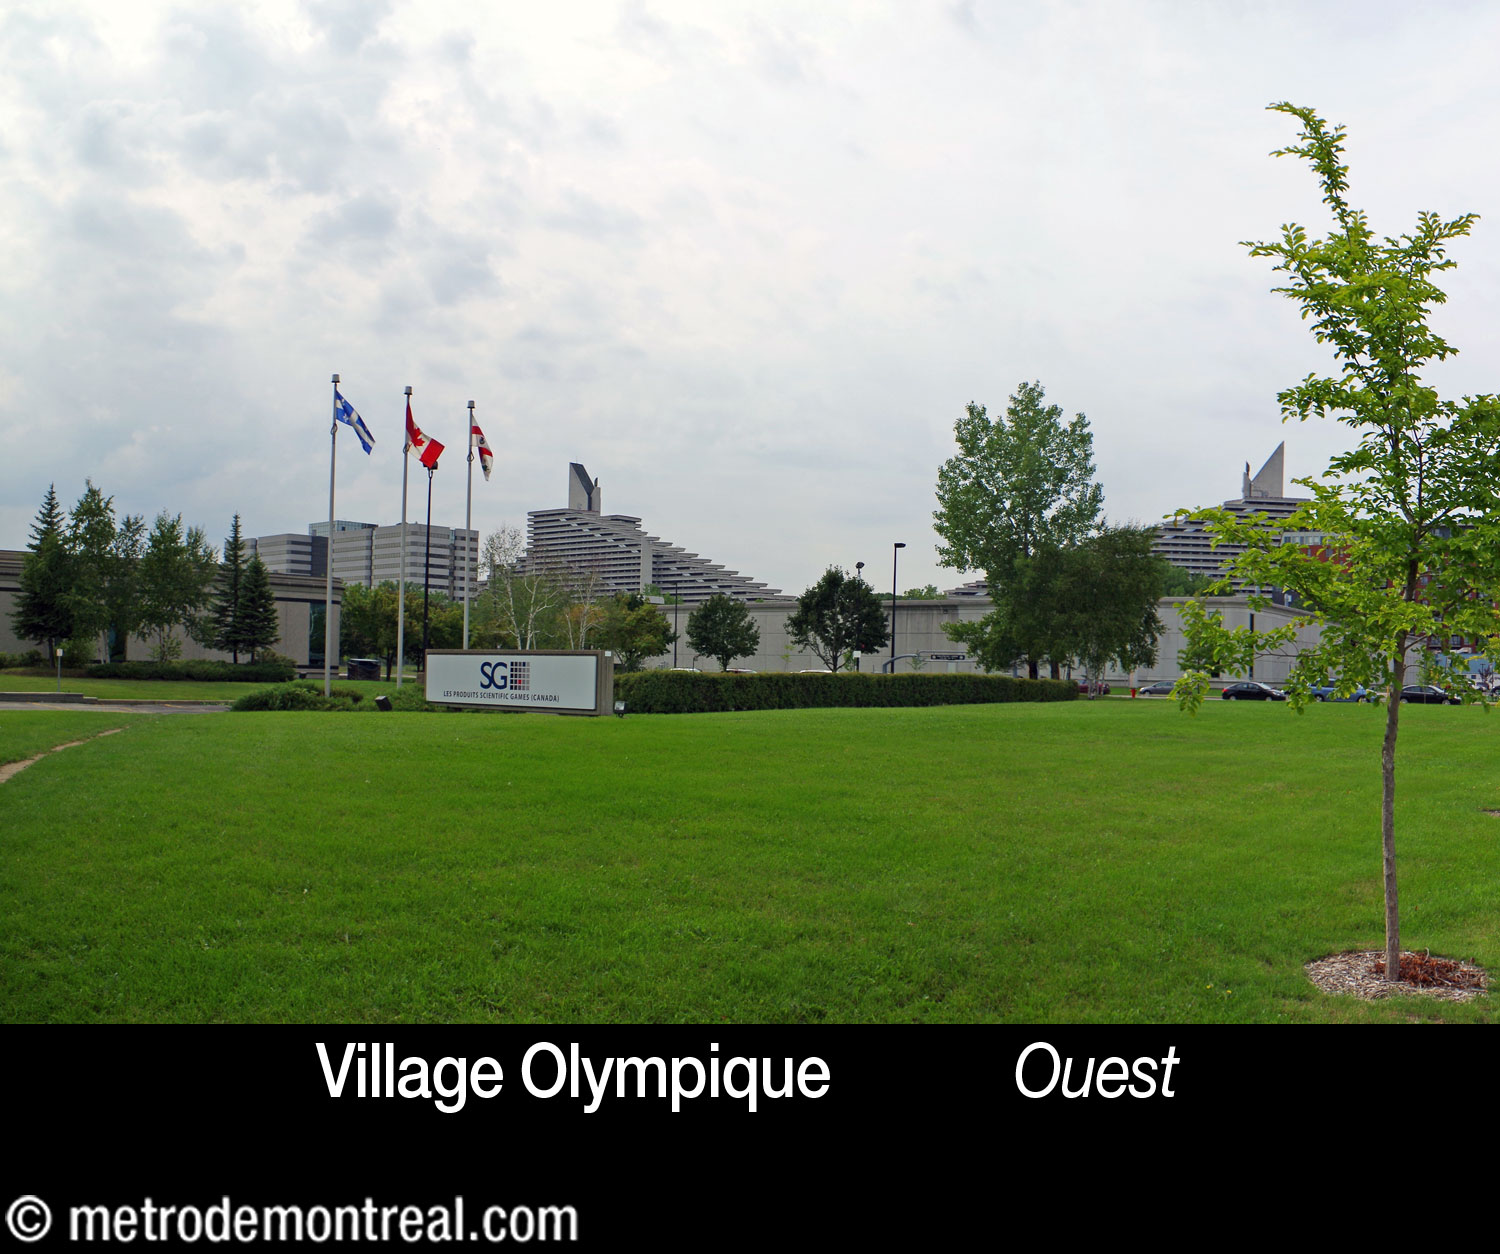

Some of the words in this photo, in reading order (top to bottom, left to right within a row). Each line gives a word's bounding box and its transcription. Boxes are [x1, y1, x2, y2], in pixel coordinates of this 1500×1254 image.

[480, 661, 508, 690] SG
[453, 690, 479, 698] PRODUITS
[480, 691, 509, 700] SCIENTIFIC
[511, 693, 530, 701] GAMES
[531, 694, 560, 702] (CANADA)
